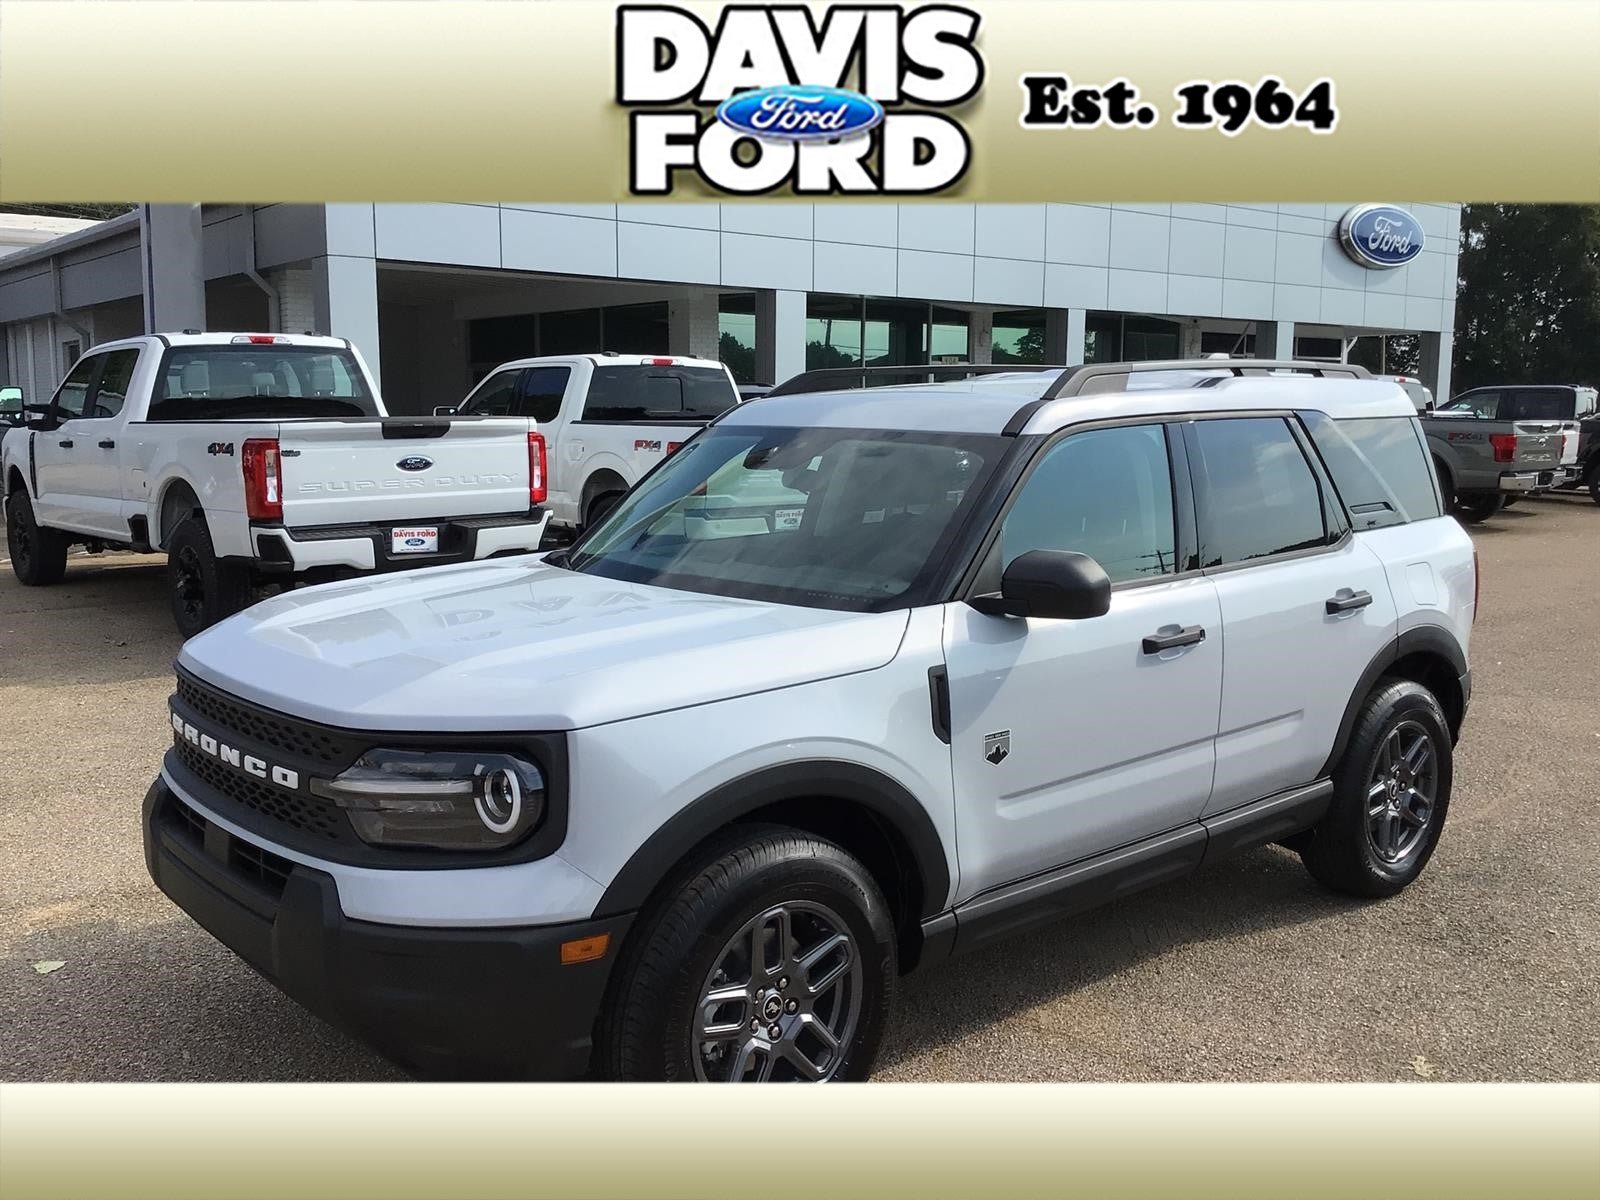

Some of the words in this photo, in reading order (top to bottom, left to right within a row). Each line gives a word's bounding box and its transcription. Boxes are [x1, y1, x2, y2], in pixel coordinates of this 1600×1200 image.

[1368, 215, 1412, 254] Ford
[298, 480, 426, 493] SUPER
[434, 472, 519, 486] DUTY
[417, 530, 437, 538] FORD
[172, 712, 299, 790] BRONCO
